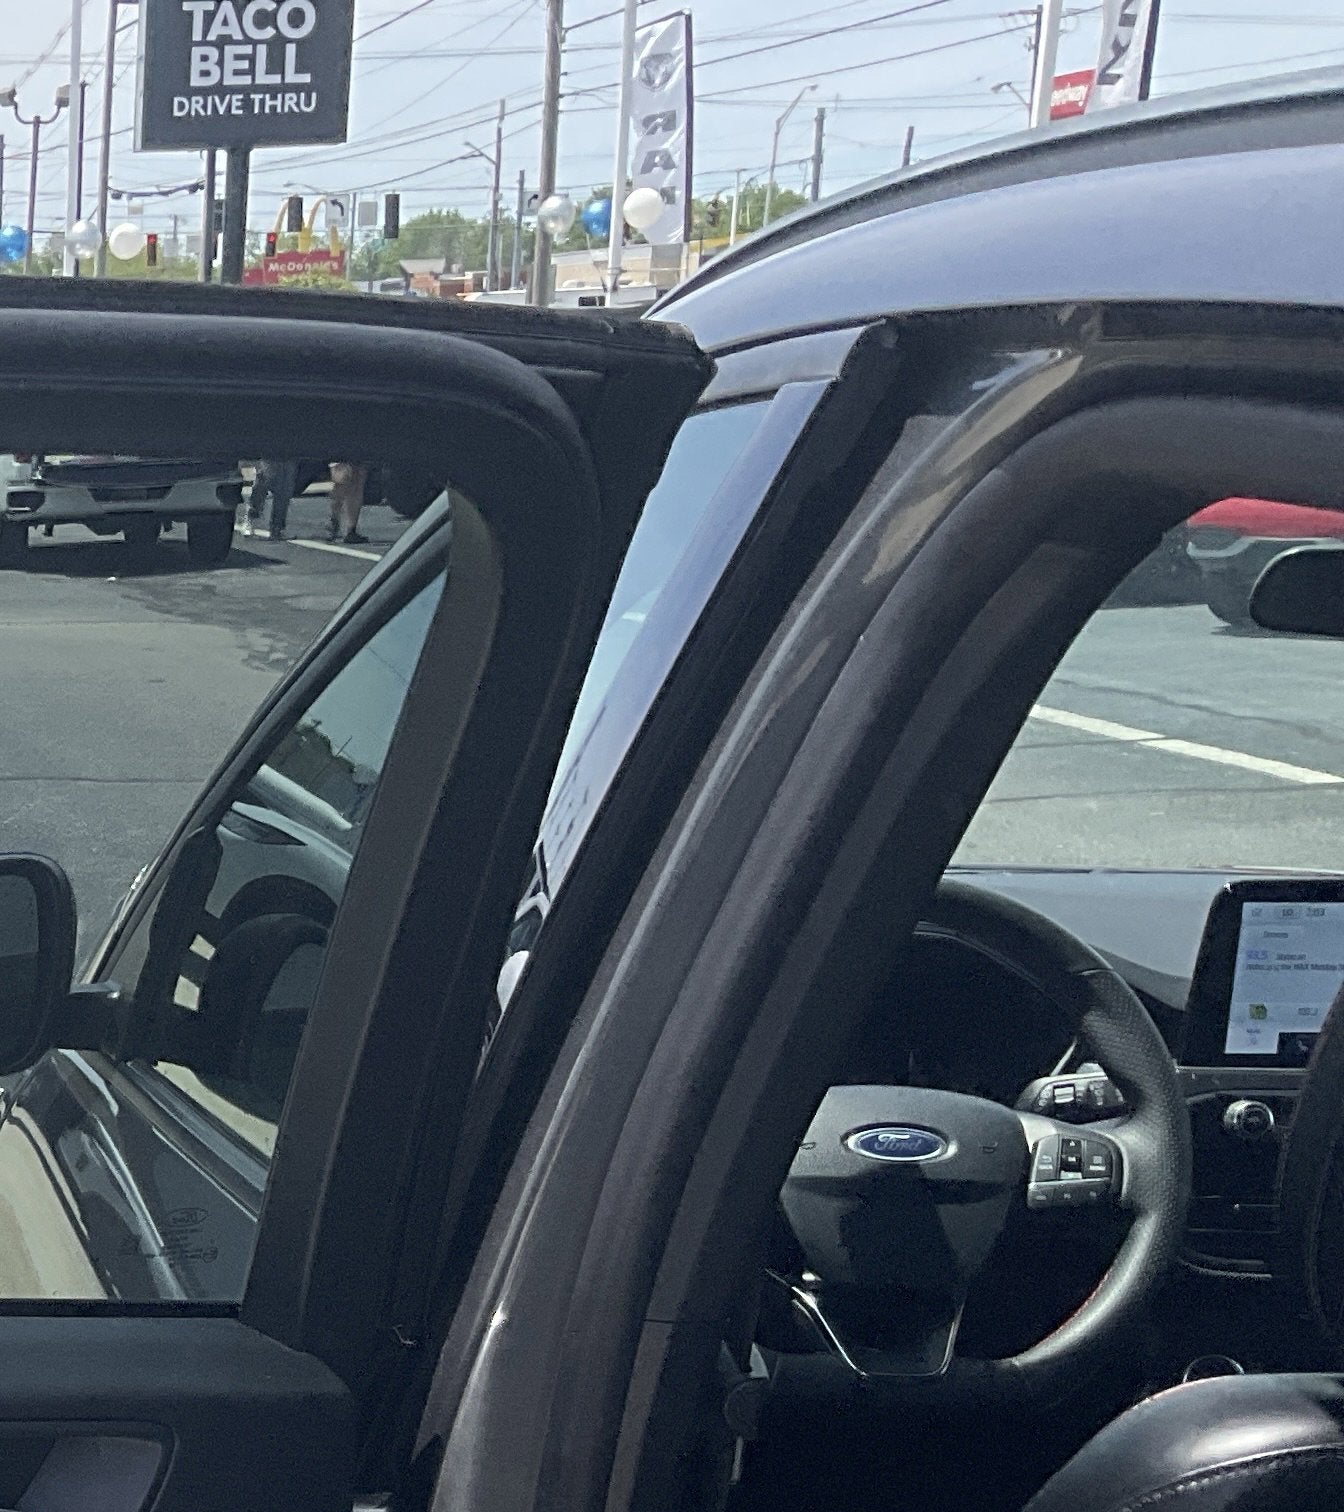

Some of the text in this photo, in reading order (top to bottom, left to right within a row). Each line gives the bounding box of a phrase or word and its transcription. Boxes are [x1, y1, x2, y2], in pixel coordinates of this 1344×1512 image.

[182, 0, 316, 41] TACO
[190, 43, 311, 87] BELL
[172, 92, 318, 117] DRIVE THRU
[874, 1133, 922, 1151] Ford
